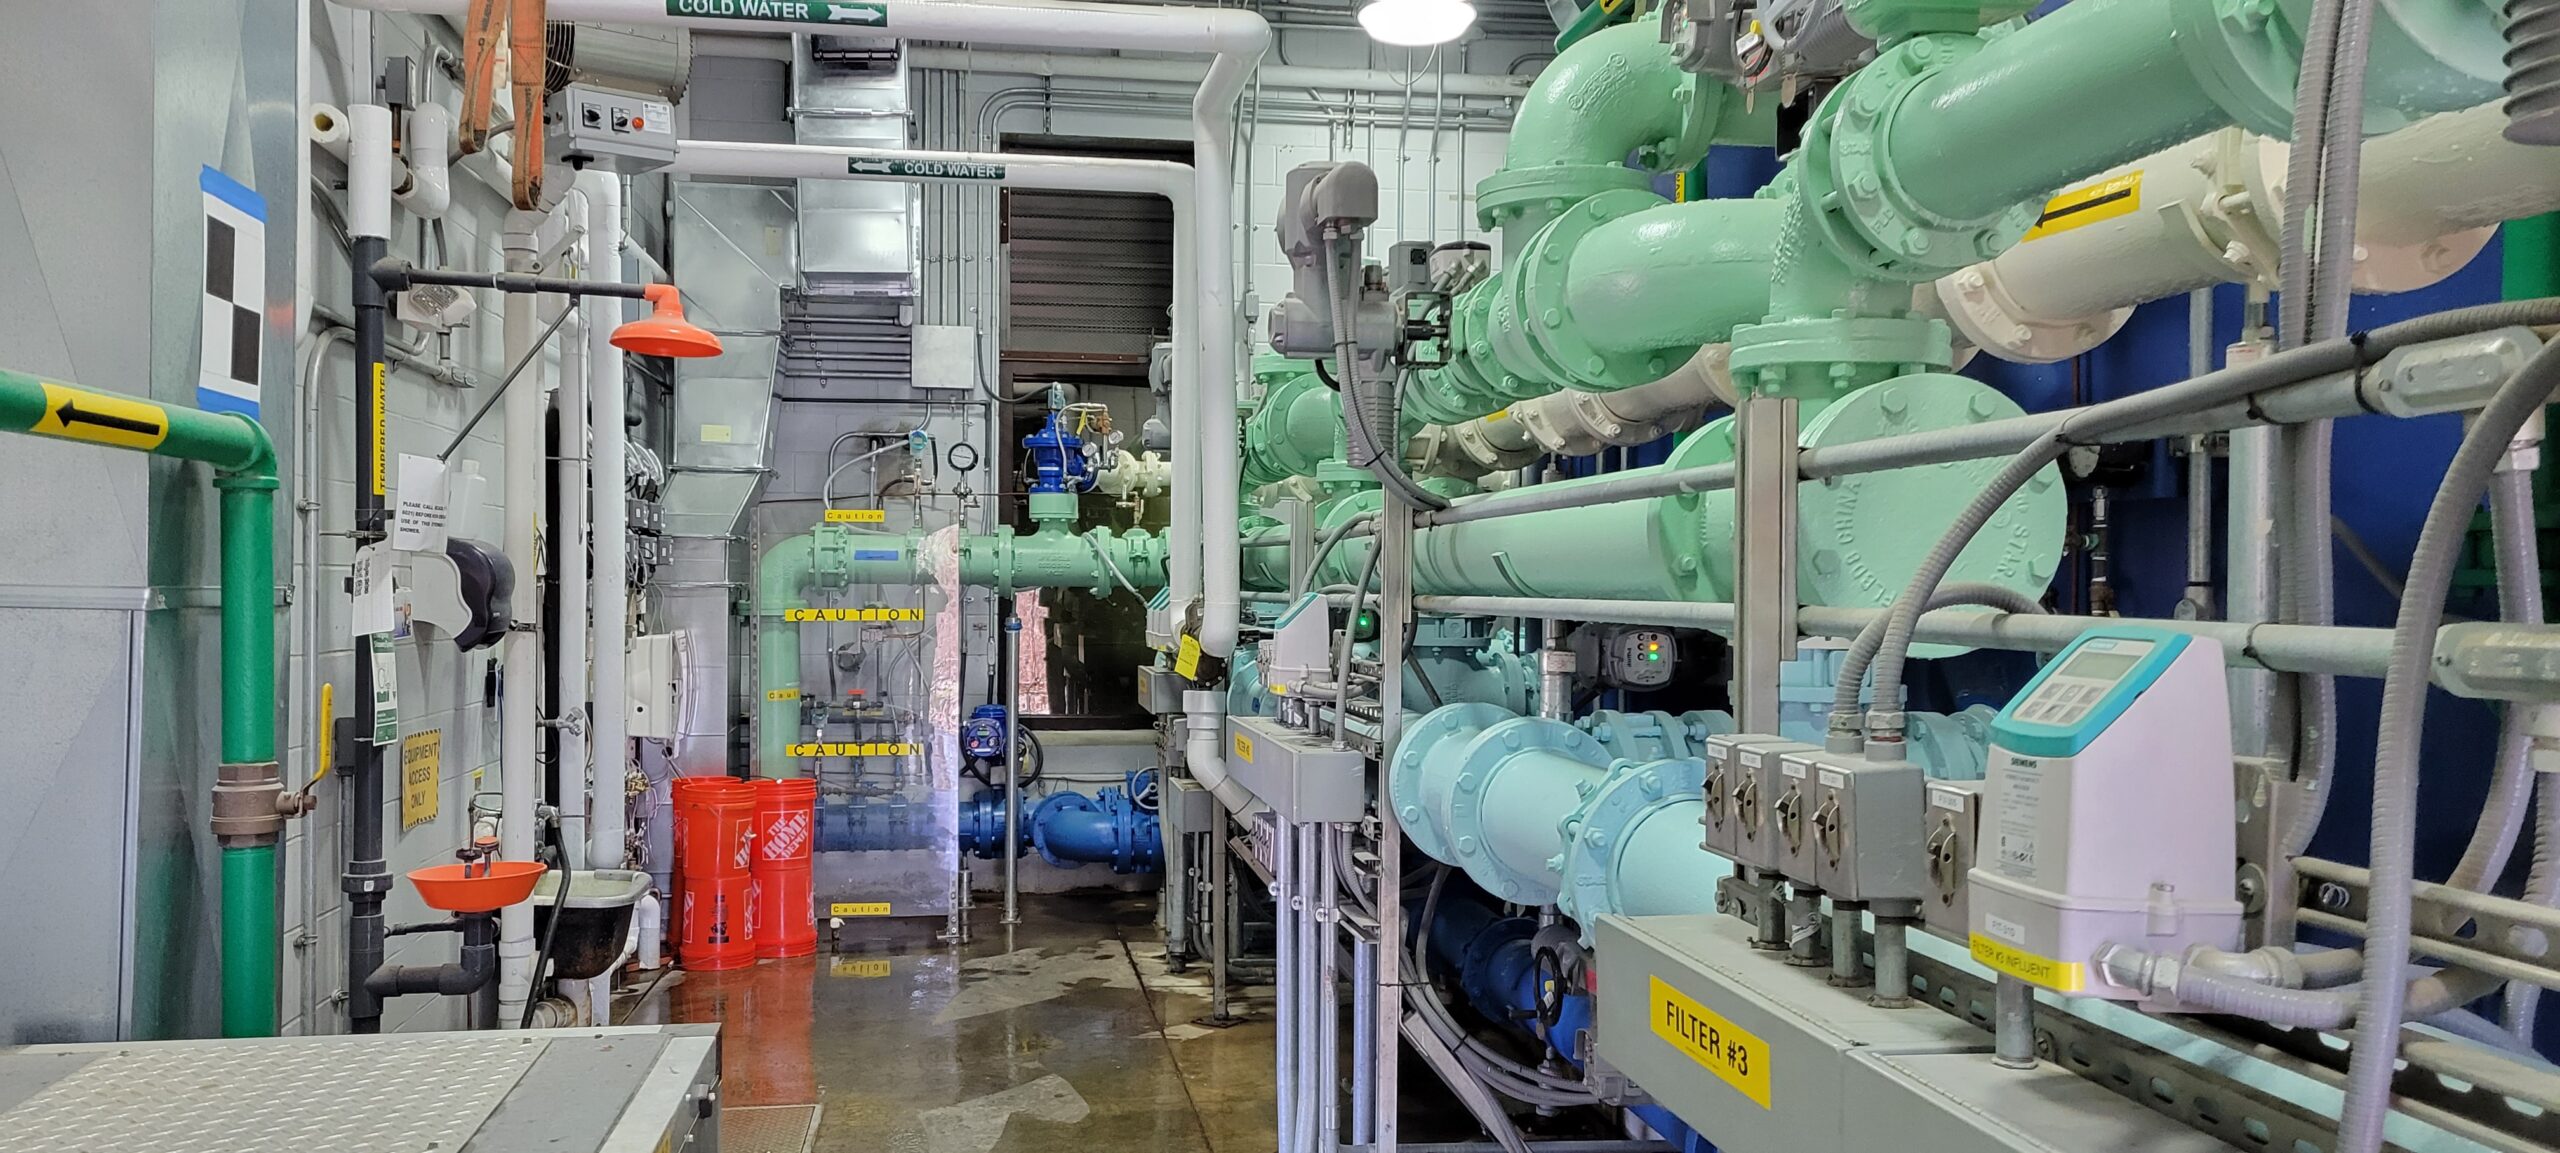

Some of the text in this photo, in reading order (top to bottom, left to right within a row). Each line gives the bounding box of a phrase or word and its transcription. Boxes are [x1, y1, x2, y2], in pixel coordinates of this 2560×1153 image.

[679, 0, 809, 19] COLD WATER
[904, 162, 996, 178] COLD WATER
[794, 609, 920, 621] CAUTION
[404, 742, 437, 765] EQUIPMENT
[794, 744, 920, 756] CAUTION
[409, 766, 431, 786] ACCESS
[411, 790, 426, 808] ONLY
[763, 810, 809, 859] HOME
[768, 815, 788, 836] THE
[782, 829, 809, 859] DEPOT
[2007, 955, 2051, 978] INFLUENT
[1666, 1000, 1721, 1060] FILTER
[1727, 1039, 1748, 1076] #3
